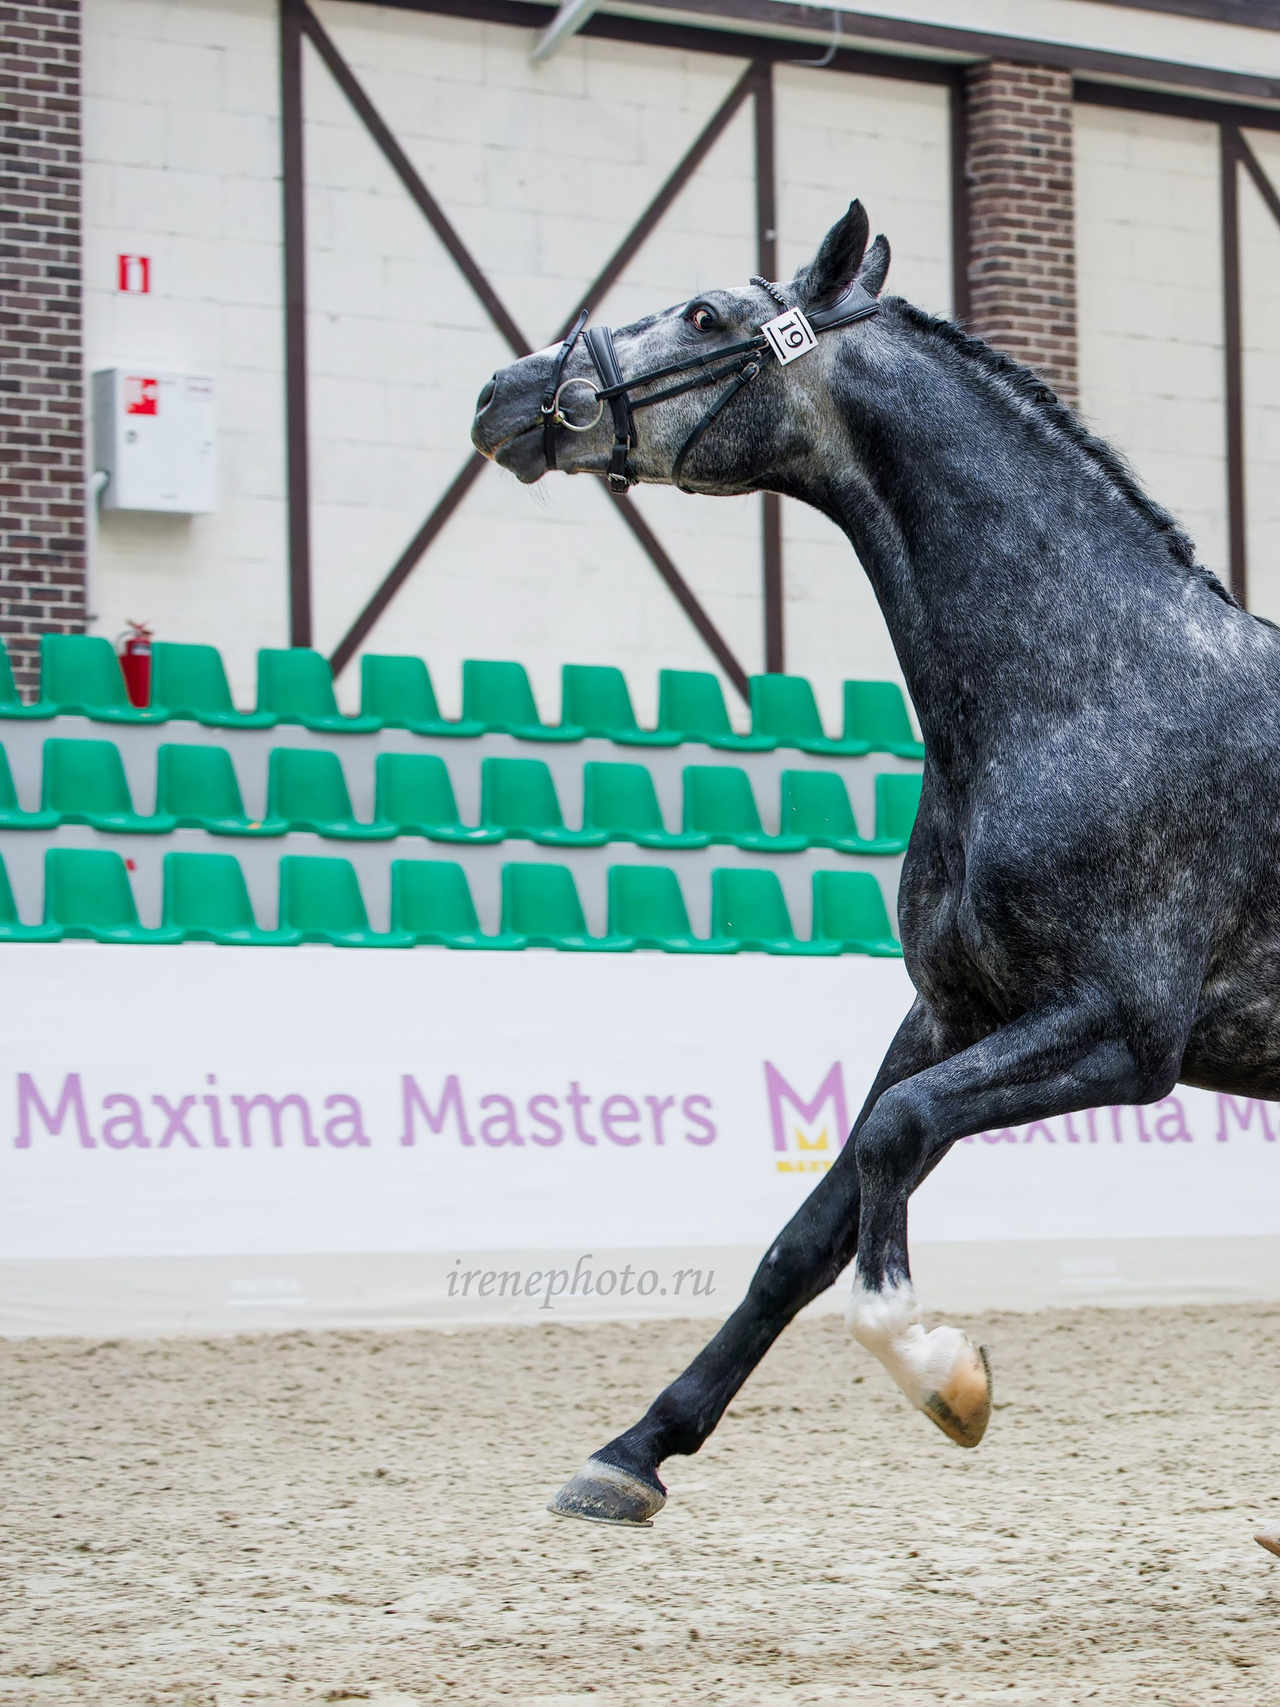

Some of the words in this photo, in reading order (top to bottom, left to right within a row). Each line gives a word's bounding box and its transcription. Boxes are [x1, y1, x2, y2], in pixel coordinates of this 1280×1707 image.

[777, 320, 804, 349] 19
[14, 1072, 372, 1149] Maxima
[399, 1074, 718, 1147] Masters
